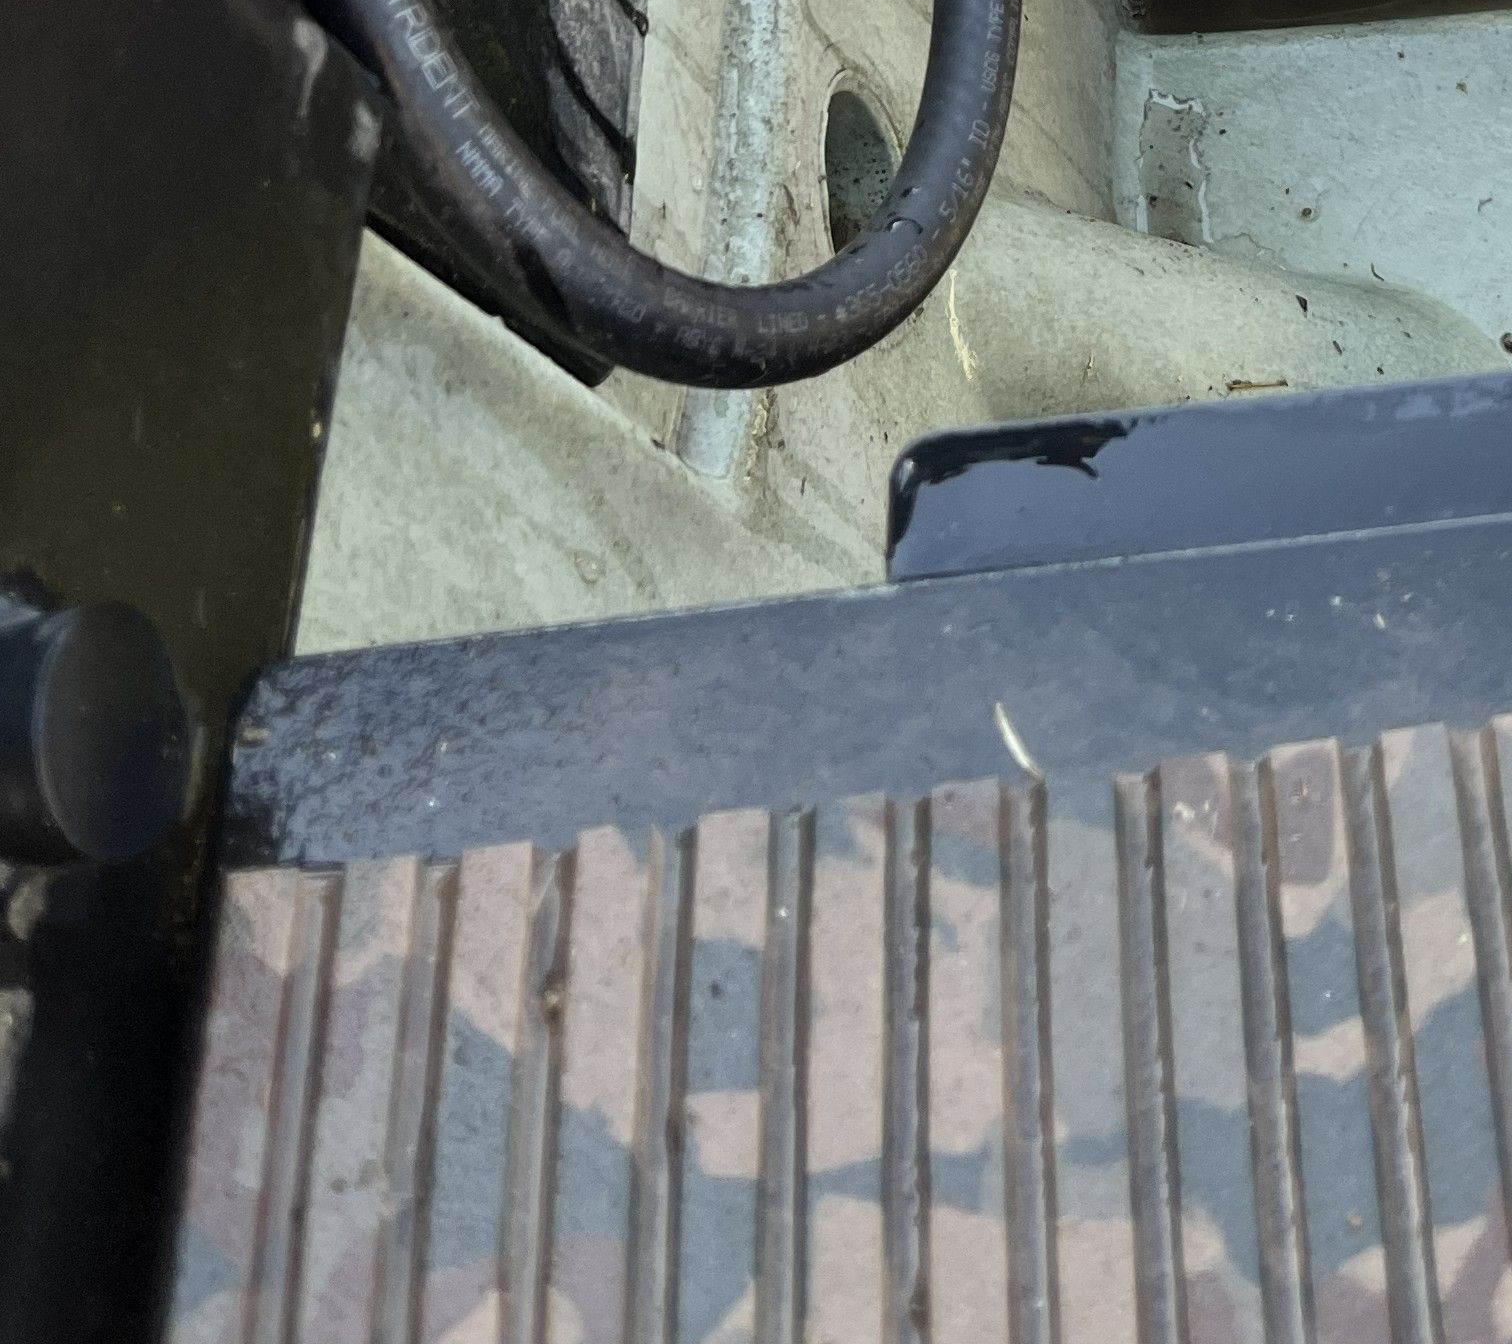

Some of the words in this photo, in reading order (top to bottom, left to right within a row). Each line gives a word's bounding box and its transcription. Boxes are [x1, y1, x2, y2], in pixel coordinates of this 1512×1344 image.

[985, 0, 1005, 41] TYPE
[978, 49, 1001, 93] USCG
[968, 119, 991, 150] ID
